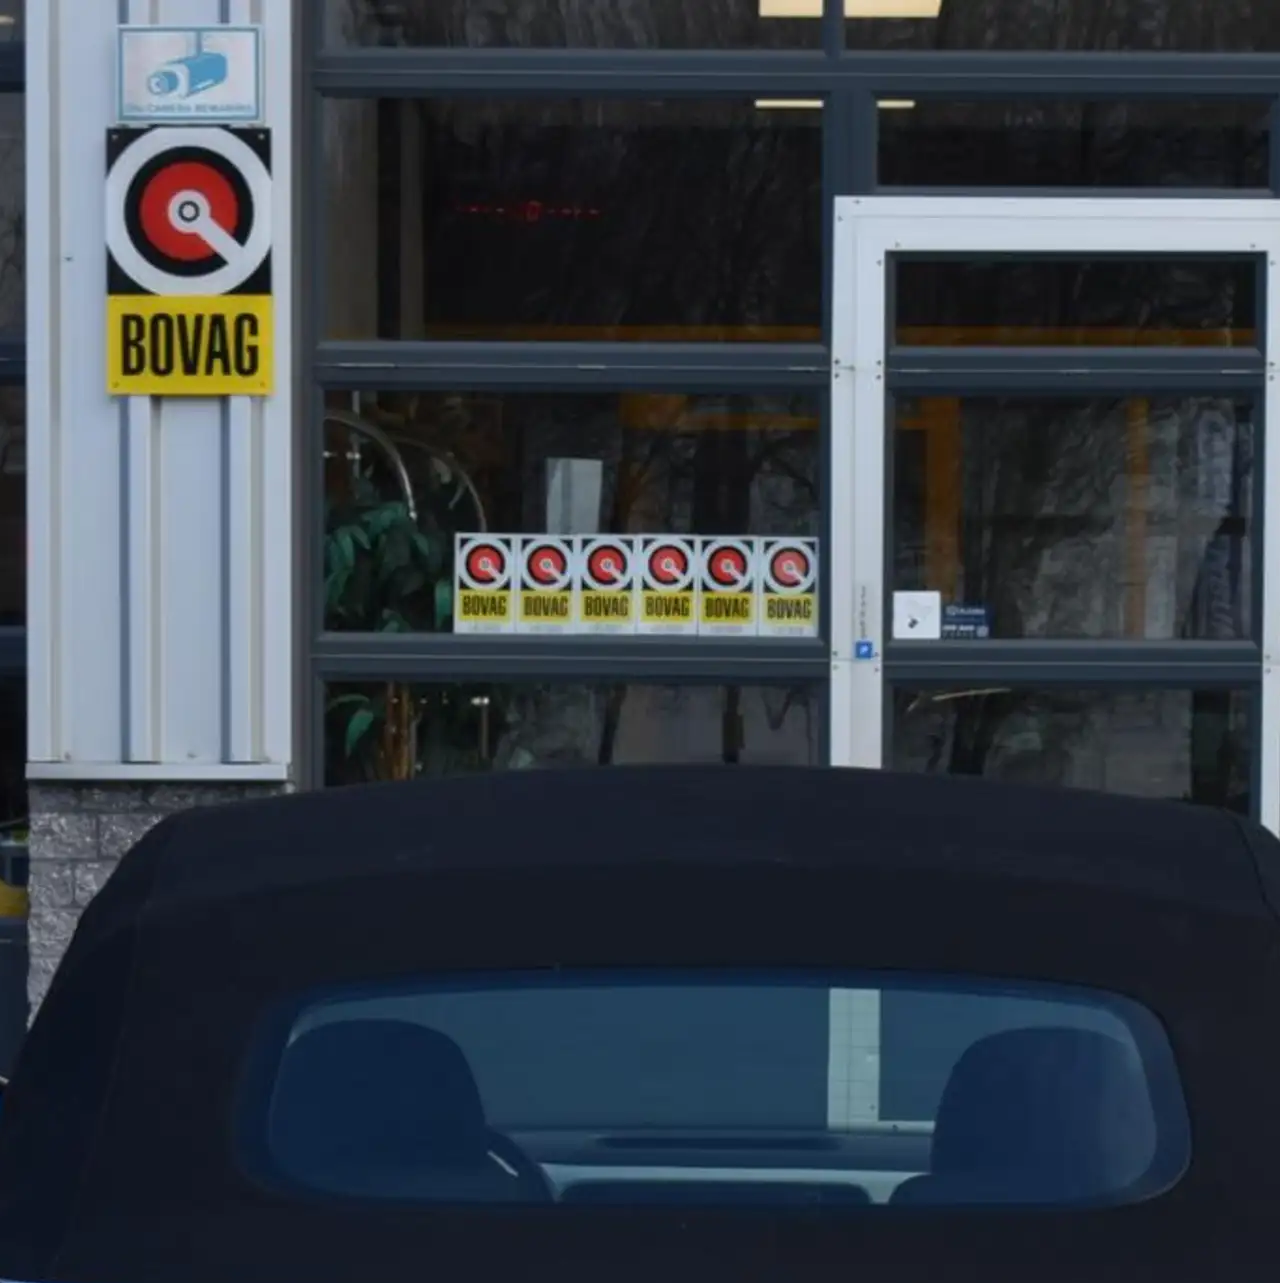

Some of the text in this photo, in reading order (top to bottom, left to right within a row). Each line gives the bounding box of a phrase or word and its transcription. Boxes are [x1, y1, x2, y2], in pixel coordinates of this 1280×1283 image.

[121, 312, 259, 377] BOVAG
[462, 596, 507, 617] BOVAG
[523, 597, 568, 618] BOVAG
[584, 597, 629, 618] BOVAG
[645, 598, 690, 618] BOVAG
[705, 598, 750, 619] BOVAG
[766, 599, 812, 620] BOVAG
